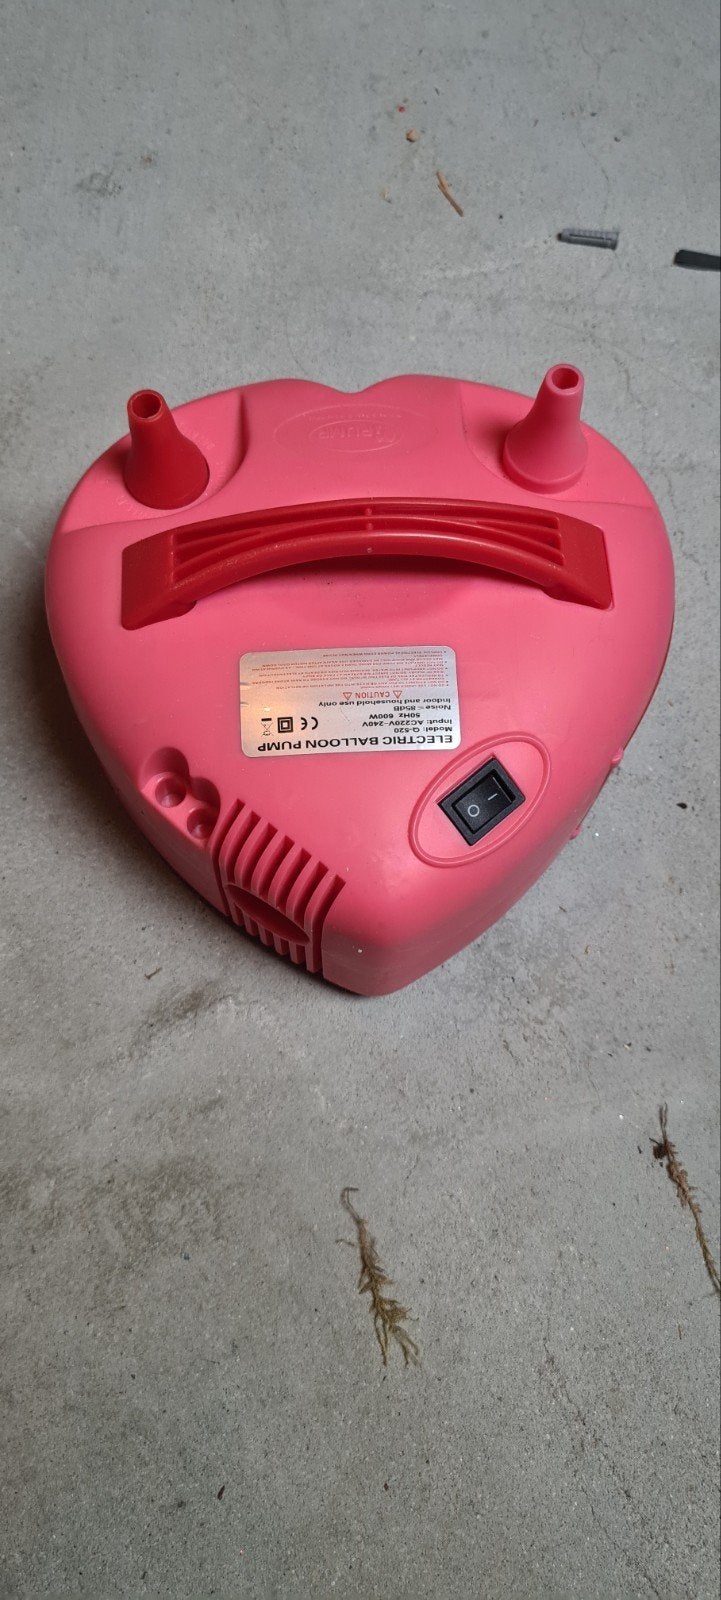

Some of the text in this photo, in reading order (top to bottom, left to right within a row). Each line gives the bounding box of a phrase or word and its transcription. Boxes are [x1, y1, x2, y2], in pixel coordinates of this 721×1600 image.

[355, 691, 390, 699] CAUTION
[257, 735, 453, 751] ELECTRIC BALLOON PUMP
